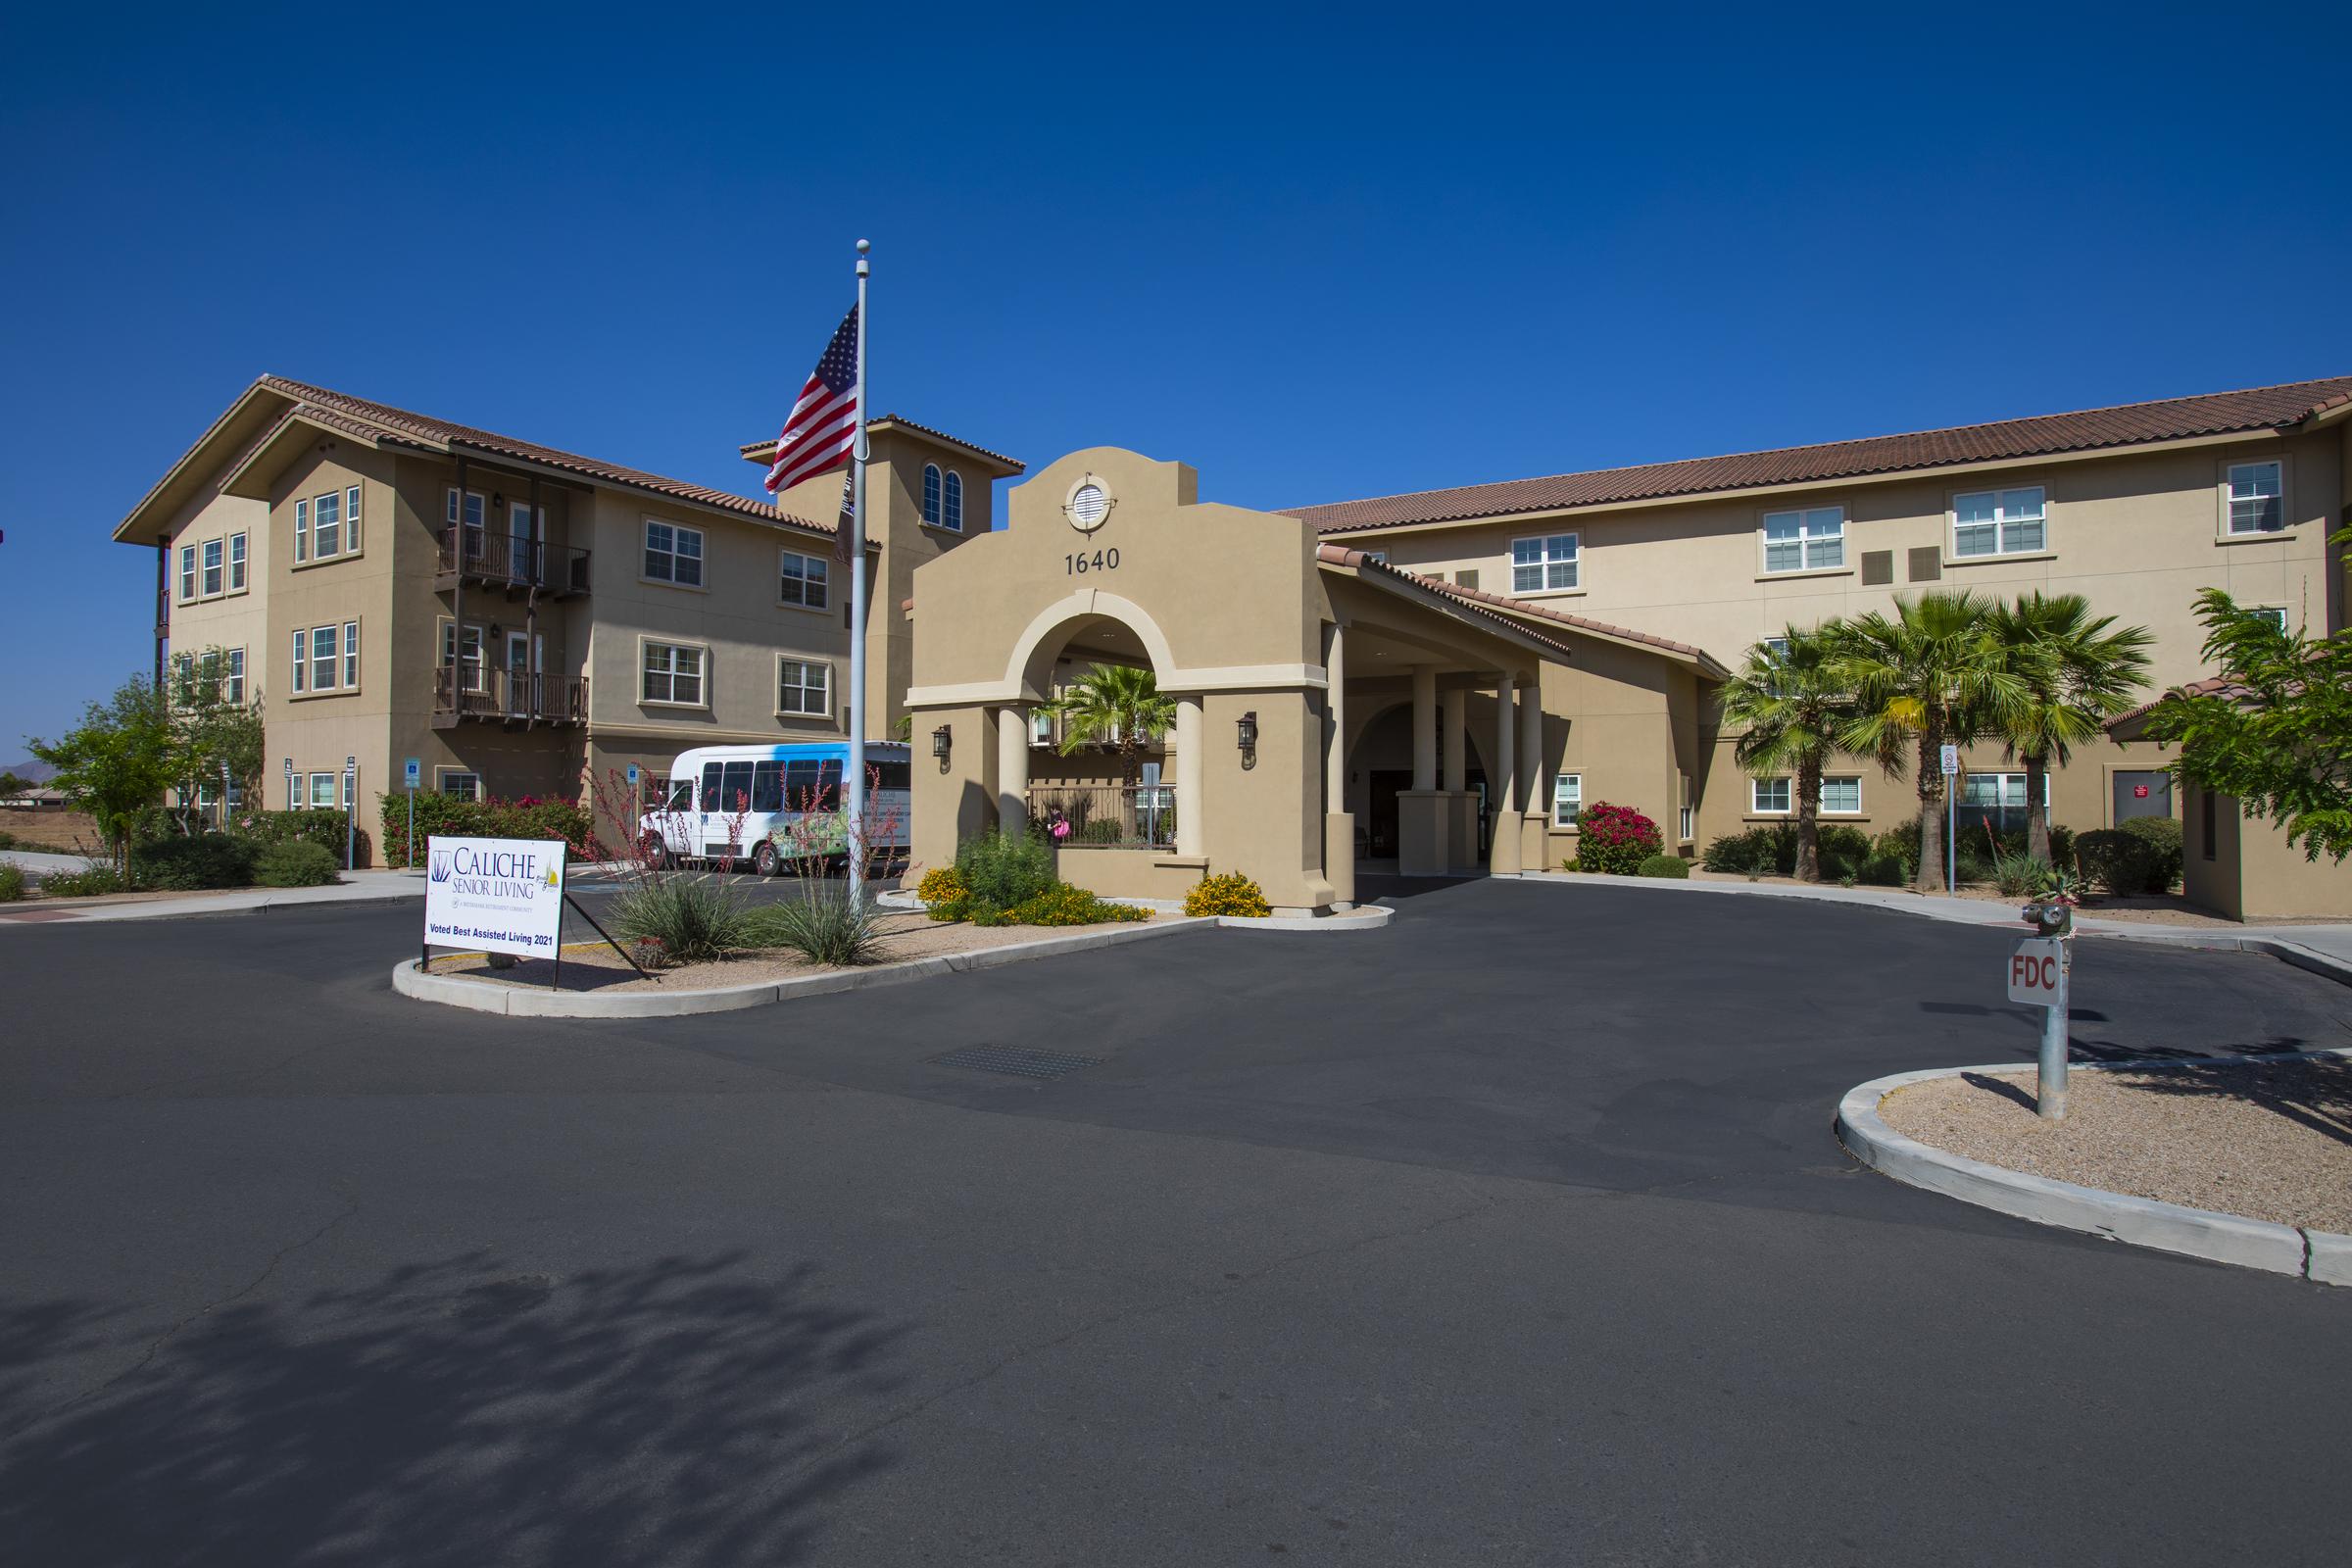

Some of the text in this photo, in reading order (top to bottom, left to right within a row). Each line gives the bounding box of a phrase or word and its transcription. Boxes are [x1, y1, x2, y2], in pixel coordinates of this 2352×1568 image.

[1065, 548, 1119, 575] 1640
[454, 847, 536, 880] CALICHE
[452, 878, 491, 896] SENIOR
[494, 881, 534, 900] LIVING
[430, 923, 553, 946] Voted Best Assisted Living 2021
[2012, 955, 2056, 991] FDC
